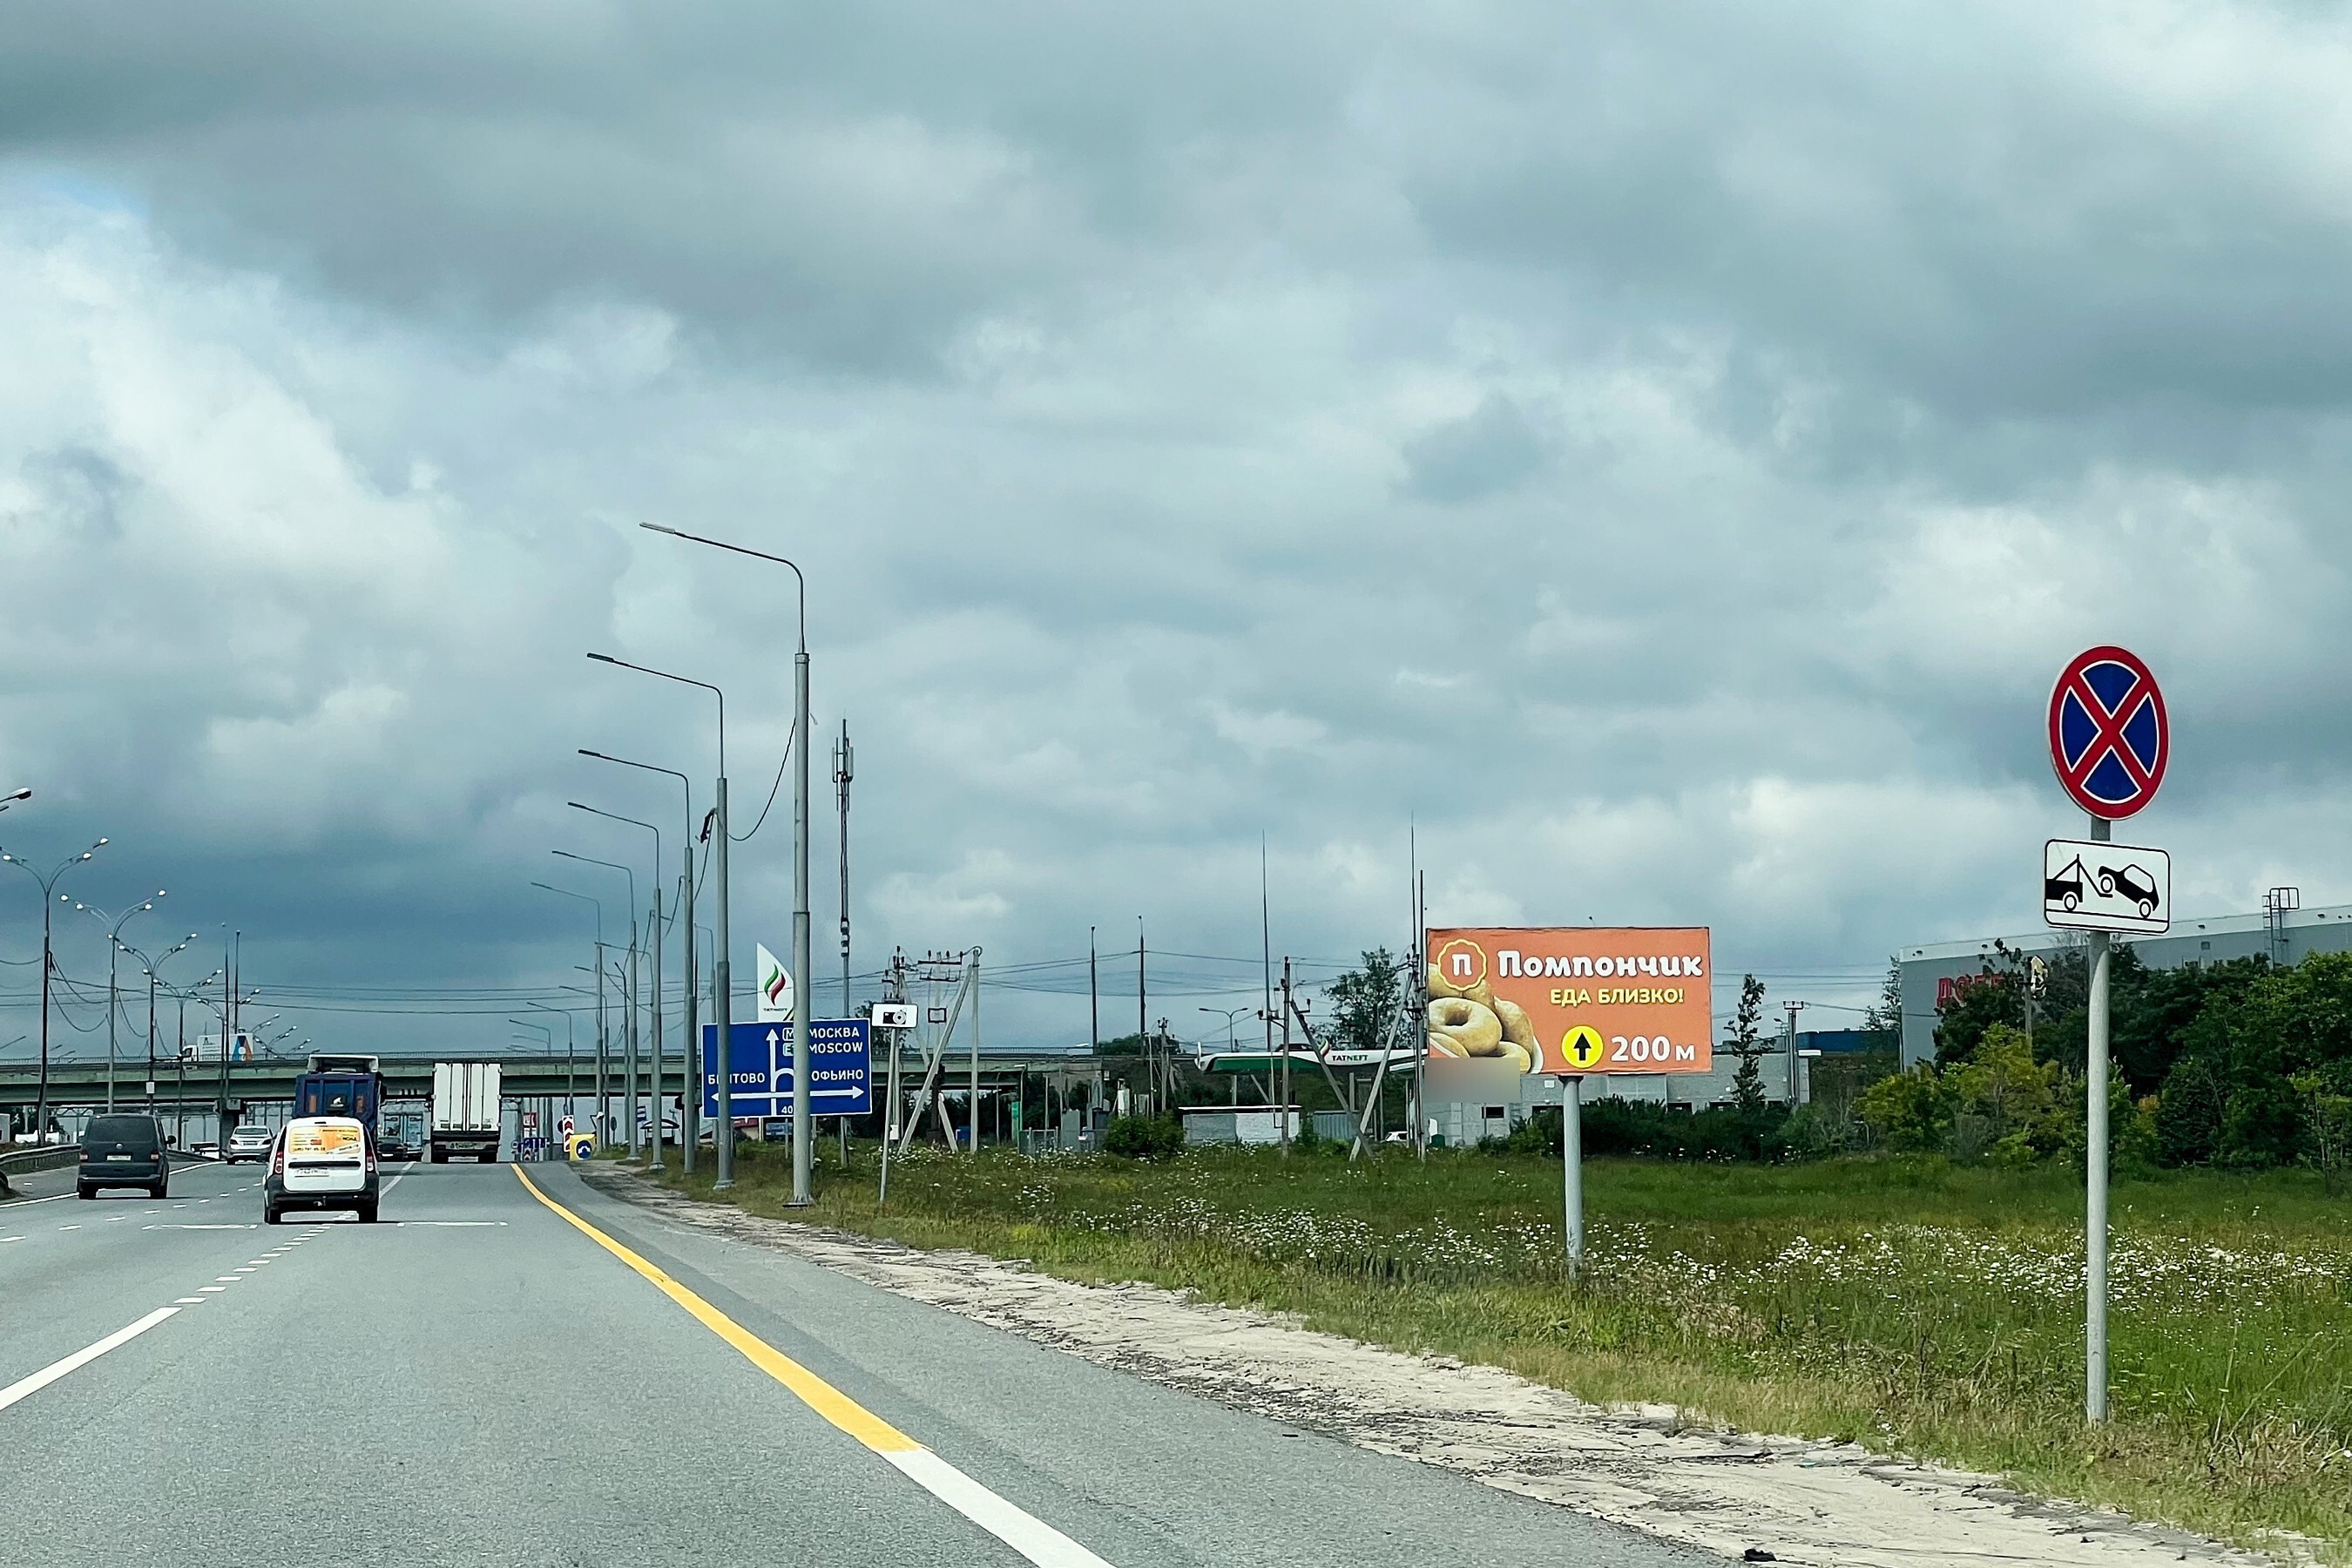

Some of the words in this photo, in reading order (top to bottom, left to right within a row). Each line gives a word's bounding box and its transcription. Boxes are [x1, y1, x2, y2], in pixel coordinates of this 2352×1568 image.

[1497, 950, 1704, 978] Помпончик
[1550, 989, 1592, 1007] ЕДА
[1598, 988, 1685, 1004] БЛИЗКО!
[808, 1026, 860, 1038] МОСКВА
[808, 1041, 863, 1054] MOSCOW
[1611, 1036, 1671, 1062] 200
[707, 1072, 766, 1085] БТОВО
[810, 1068, 864, 1081] ОФЬИНО
